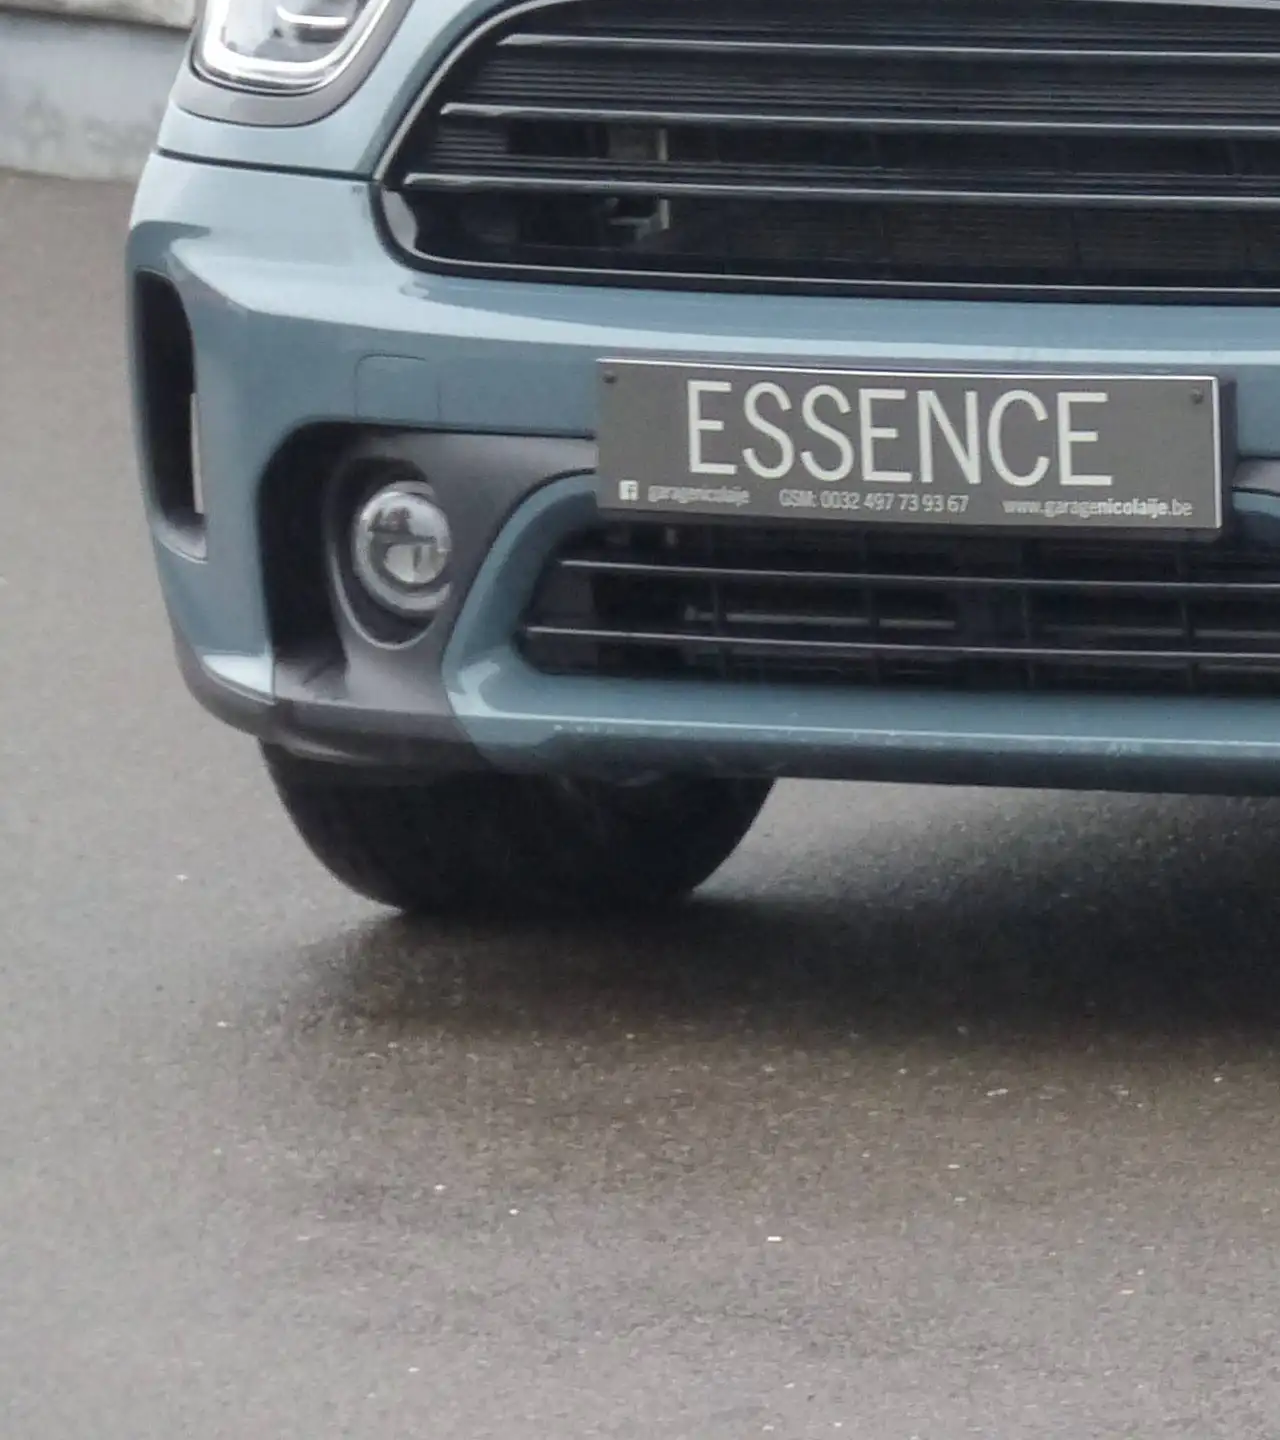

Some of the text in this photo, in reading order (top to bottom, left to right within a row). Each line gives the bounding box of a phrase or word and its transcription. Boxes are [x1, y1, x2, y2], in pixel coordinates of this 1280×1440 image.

[687, 379, 1113, 487] ESSENCE
[819, 490, 861, 510] 0032
[863, 492, 895, 511] 497
[897, 493, 919, 512] 73
[921, 494, 944, 512] 93
[947, 494, 969, 514] 67
